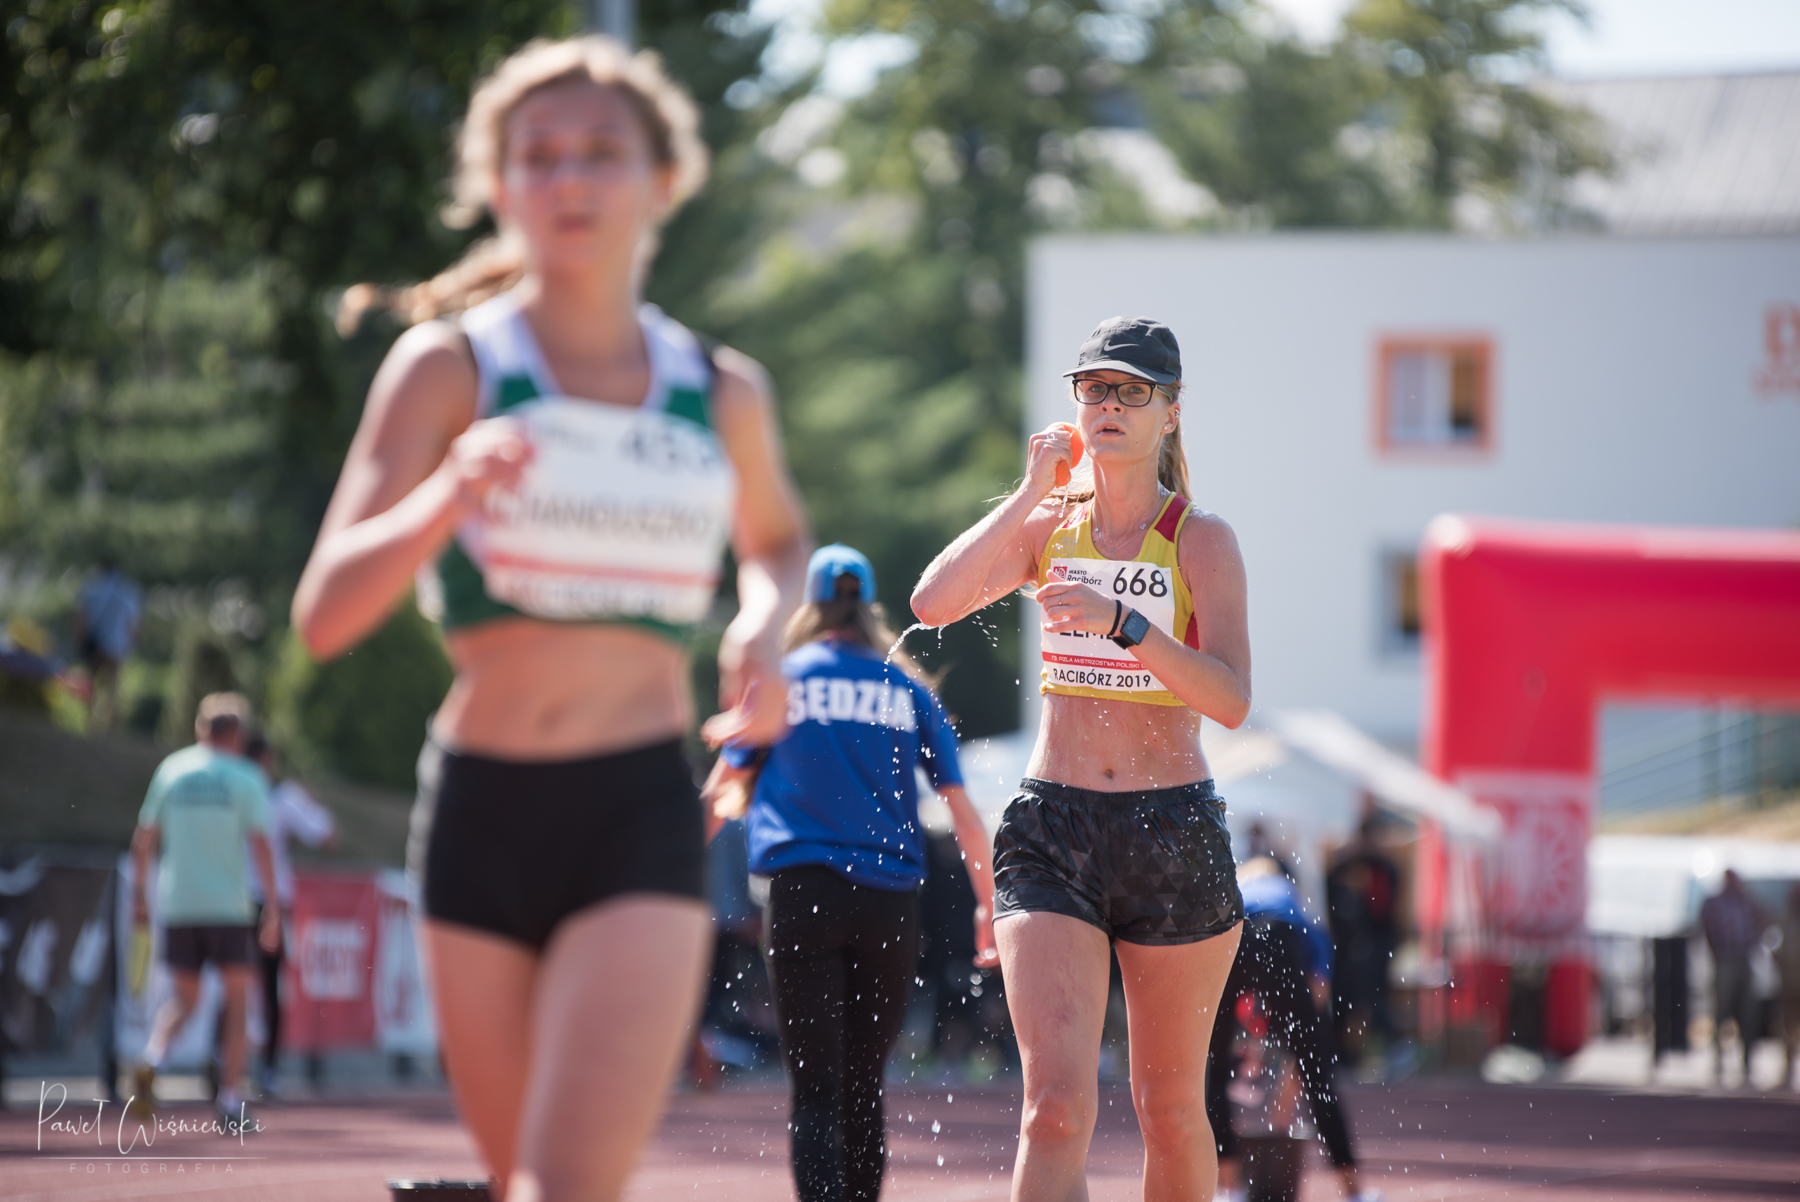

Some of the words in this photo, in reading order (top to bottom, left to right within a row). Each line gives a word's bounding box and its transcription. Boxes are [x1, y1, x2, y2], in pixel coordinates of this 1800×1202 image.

[1112, 567, 1168, 598] 668
[1074, 657, 1115, 668] MISTRZOSTWA
[1116, 661, 1140, 669] POLSKI
[1052, 668, 1112, 687] RACIBÓRZ
[1116, 674, 1151, 688] 2019
[785, 676, 917, 733] SĘDZIA
